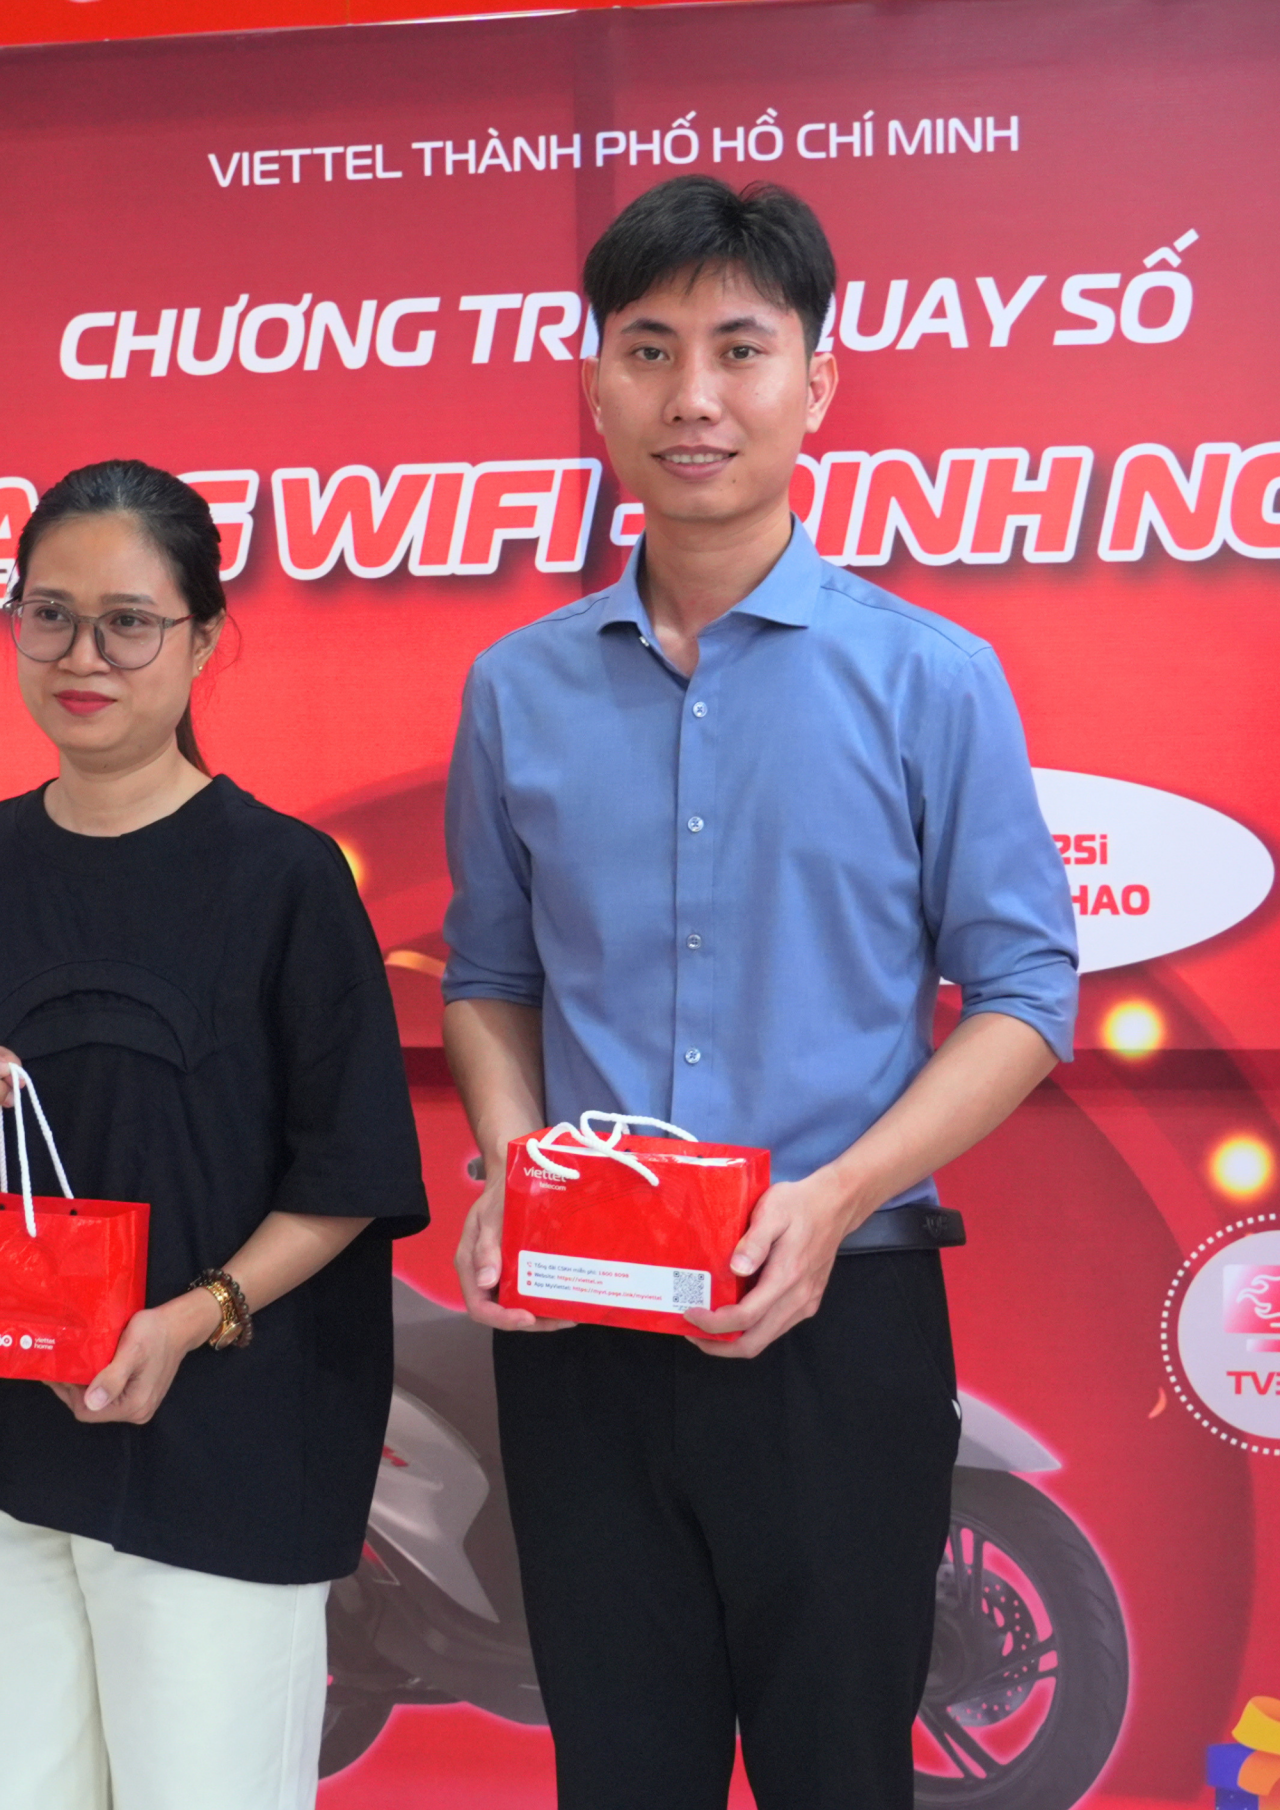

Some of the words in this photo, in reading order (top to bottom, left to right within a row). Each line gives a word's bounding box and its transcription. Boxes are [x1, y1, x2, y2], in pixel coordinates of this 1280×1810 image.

[207, 144, 403, 188] VIETTEL
[411, 126, 581, 177] THÀNH
[595, 110, 700, 167] PHỐ
[713, 107, 784, 163] HỒ
[796, 110, 875, 159] CHÍ
[887, 115, 1020, 156] MINH
[59, 292, 441, 381] CHƯƠNG
[814, 274, 1049, 352] UAY
[1052, 228, 1200, 346] SỐ
[270, 457, 603, 583] WIFI
[1069, 883, 1151, 917] HAO
[1227, 1371, 1280, 1396] TV
